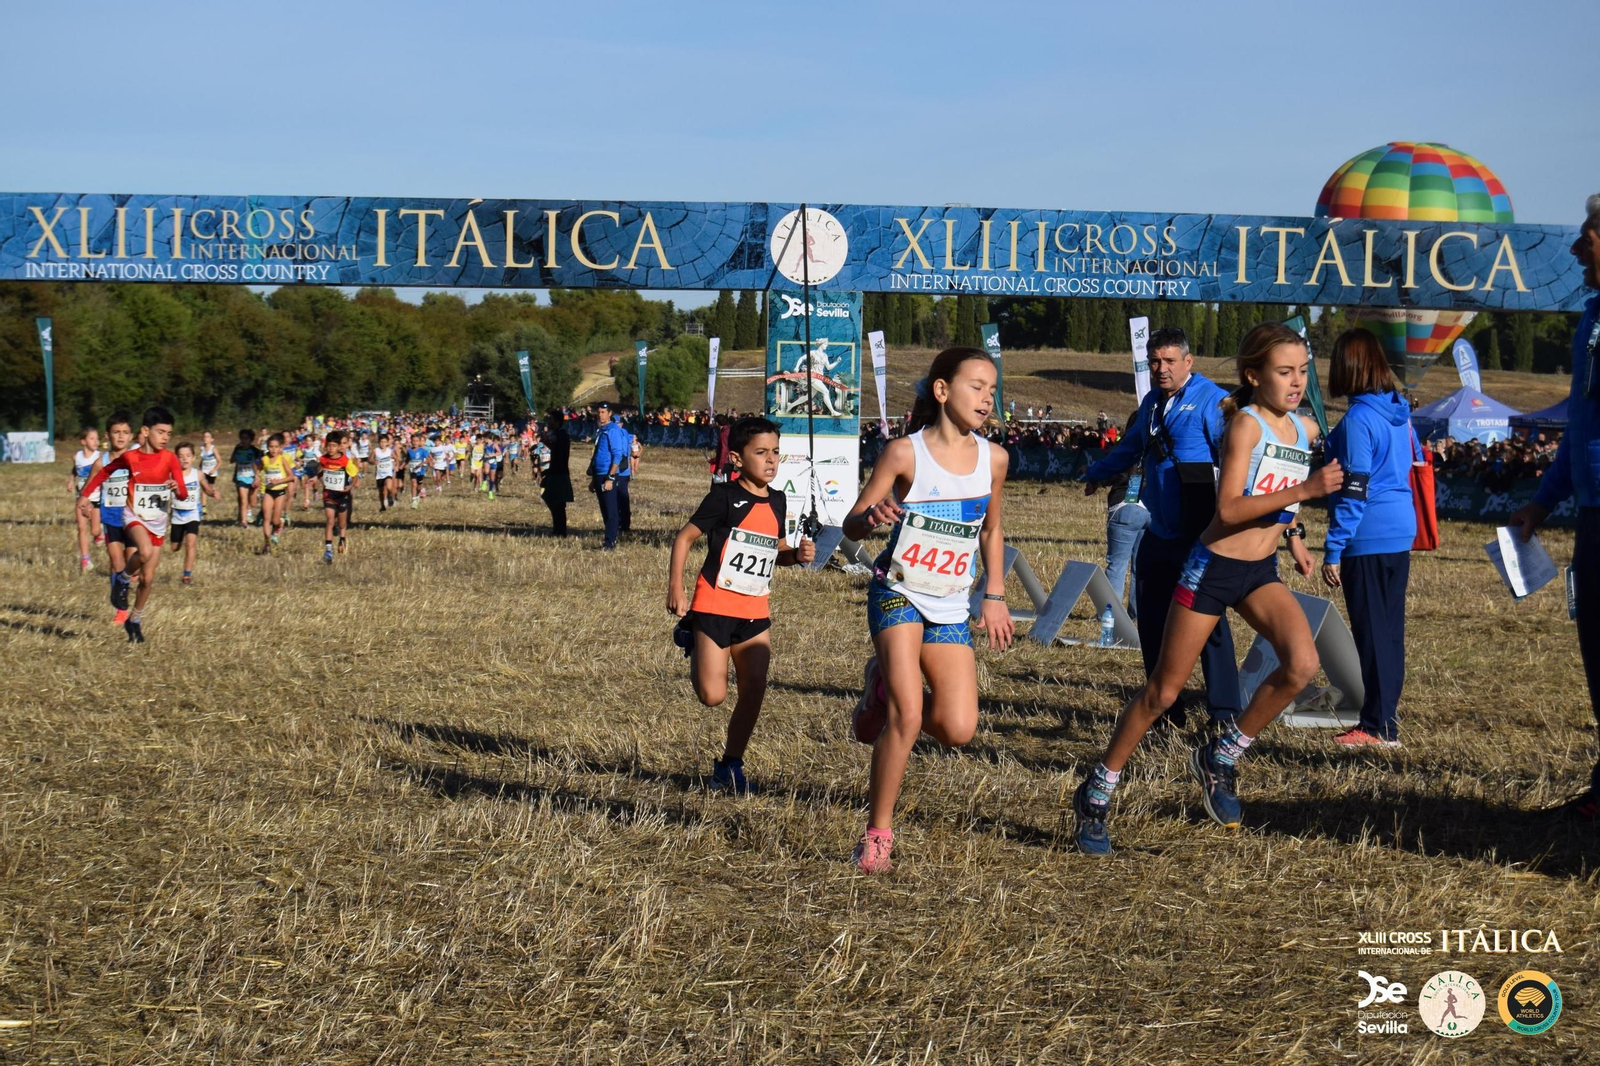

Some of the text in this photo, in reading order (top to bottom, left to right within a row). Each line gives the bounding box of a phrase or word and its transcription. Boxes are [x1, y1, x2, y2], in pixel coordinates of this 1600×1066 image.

[26, 206, 315, 259] XLIII CROSS
[373, 198, 675, 270] ITÁLICA
[190, 243, 361, 261] INTERNACIONAL
[891, 218, 1178, 272] XLIII CROSS
[1233, 217, 1533, 293] ITÁLICA
[25, 262, 331, 281] INTERNATIONAL CROSS COUNTRY
[1054, 257, 1222, 278] INTERNACIONAL
[890, 273, 1191, 296] INTERNATIONAL CROSS COUNTRY
[816, 308, 850, 318] Sevilla
[324, 474, 343, 485] 4137
[929, 521, 966, 536] ITÁLICA
[729, 552, 774, 578] 4211
[901, 543, 970, 577] 4426
